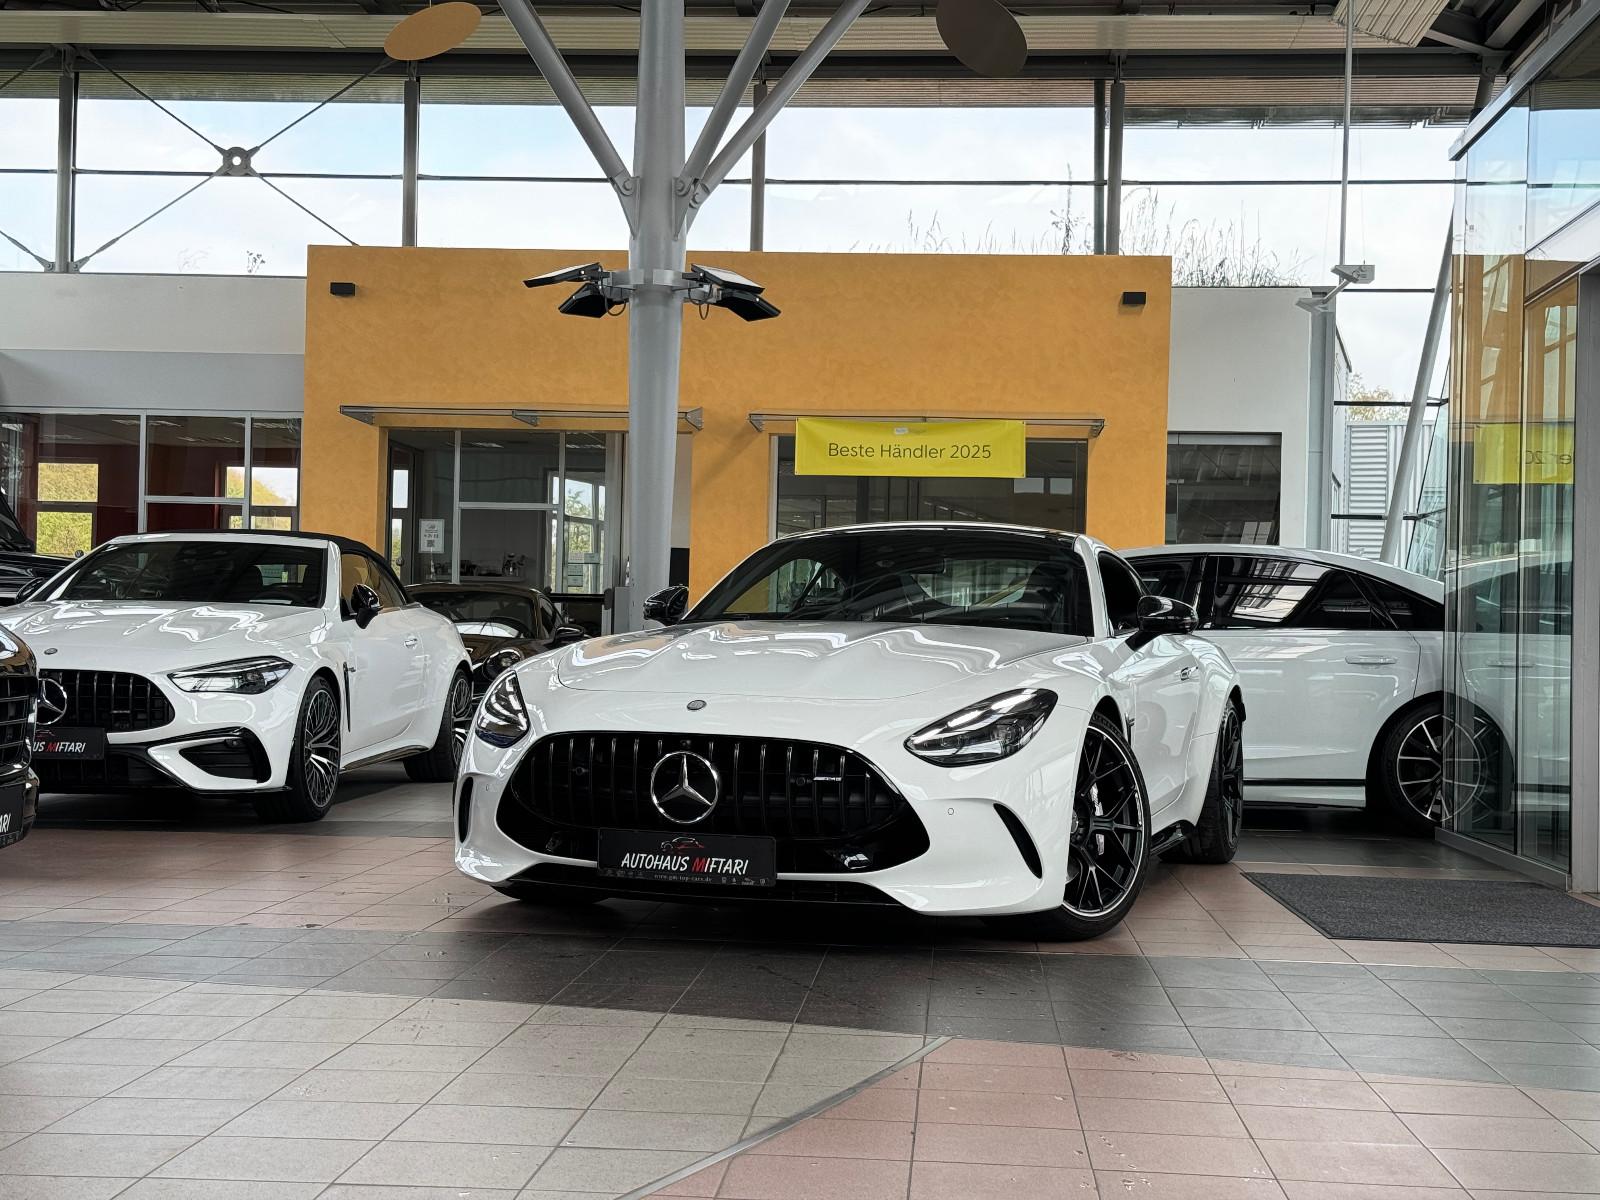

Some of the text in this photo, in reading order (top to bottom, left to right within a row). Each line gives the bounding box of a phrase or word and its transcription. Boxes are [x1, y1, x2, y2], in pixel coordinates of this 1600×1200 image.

[828, 442, 992, 459] Beste Händler 2025
[47, 741, 87, 753] MIFTARI
[621, 852, 749, 876] AUTOHAUS MIFTARI
